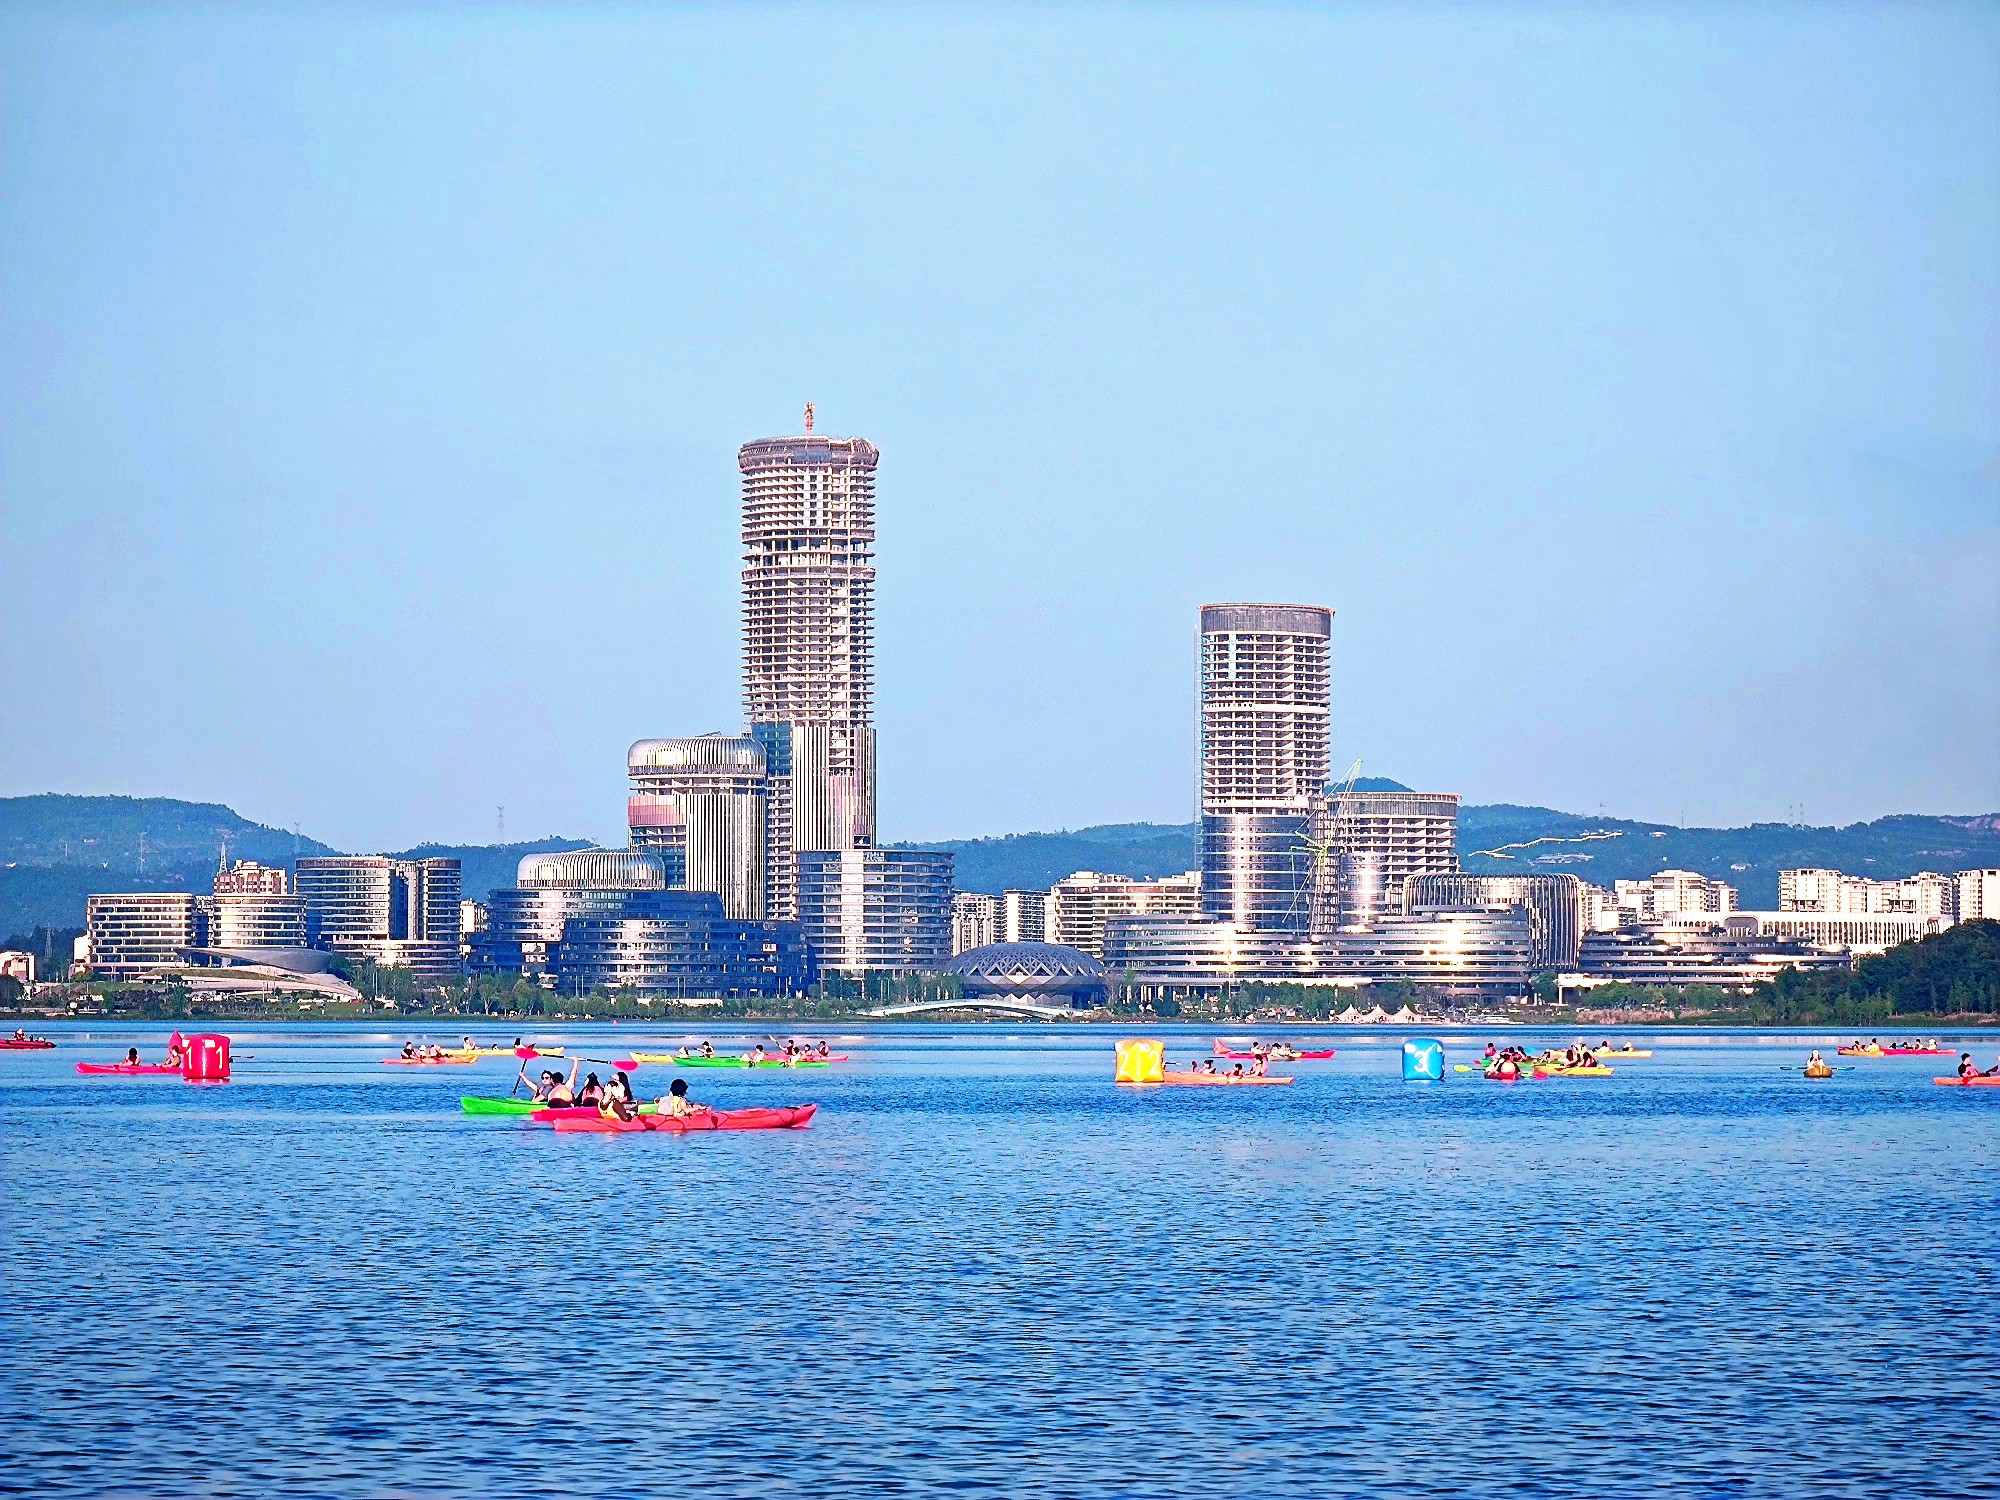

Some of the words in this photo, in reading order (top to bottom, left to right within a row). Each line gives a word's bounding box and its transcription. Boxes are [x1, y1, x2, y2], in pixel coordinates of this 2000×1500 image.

[186, 1046, 192, 1070] 1
[215, 1045, 223, 1070] 1
[1119, 1050, 1129, 1075] 2
[1148, 1050, 1161, 1075] 2
[1413, 1050, 1427, 1073] 3
